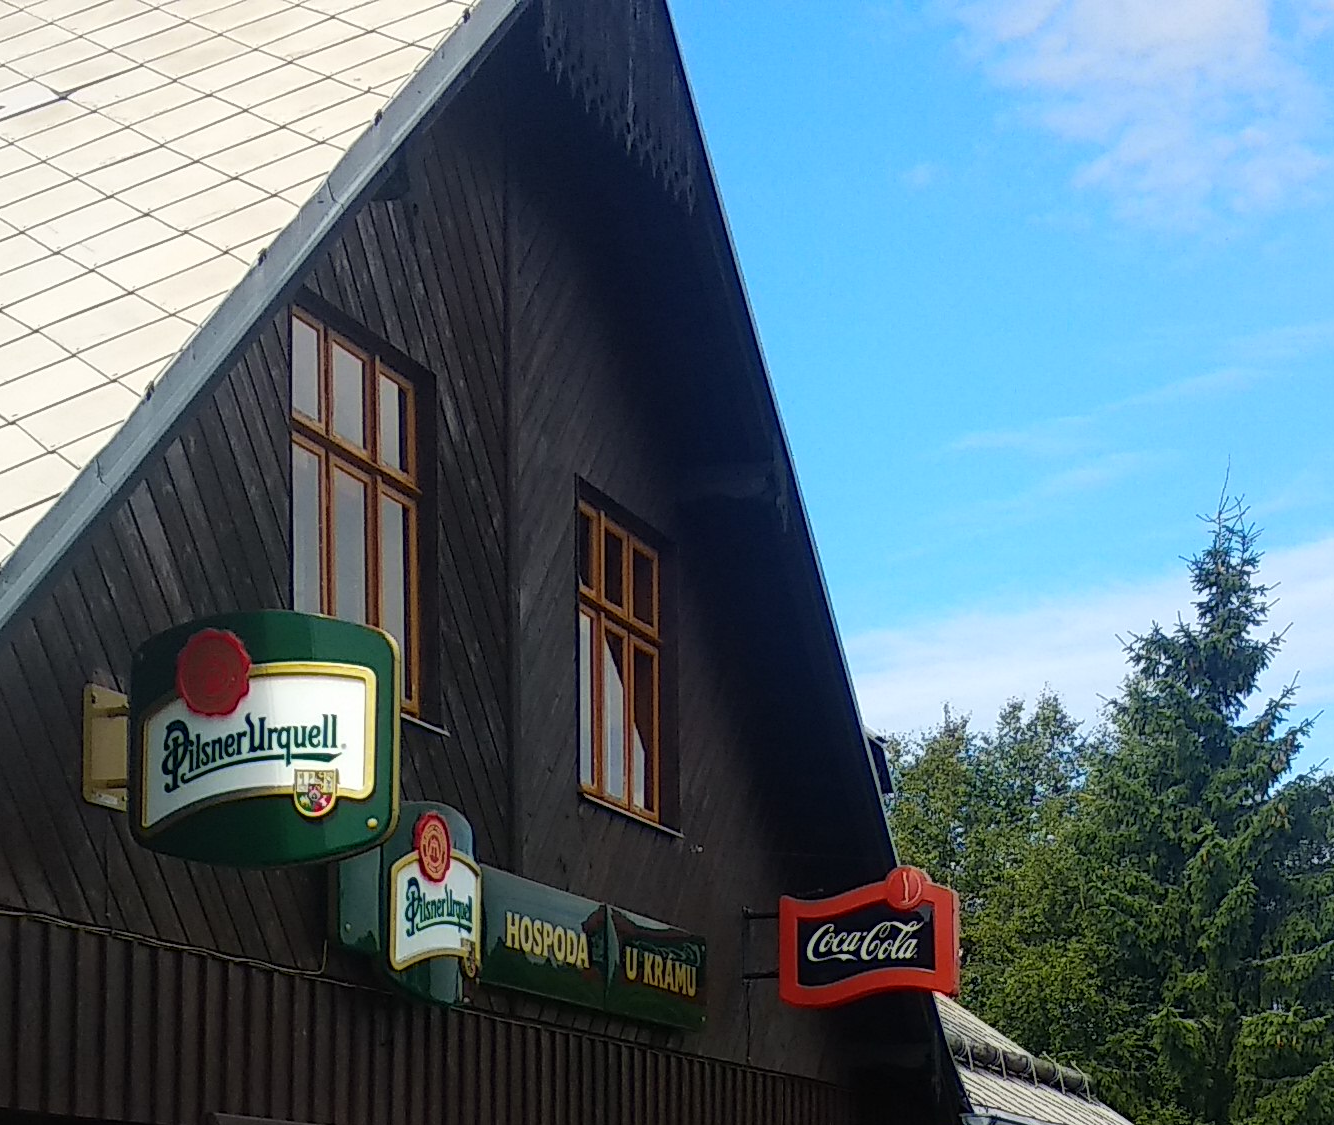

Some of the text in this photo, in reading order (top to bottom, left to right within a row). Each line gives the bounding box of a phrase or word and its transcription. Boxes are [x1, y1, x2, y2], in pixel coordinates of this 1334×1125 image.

[161, 712, 338, 793] Pilsner Urquell
[405, 876, 446, 937] Pilsner
[505, 911, 590, 969] HOSPODA
[806, 920, 925, 962] Coca-Cola
[625, 946, 697, 998] U KRÁMU
